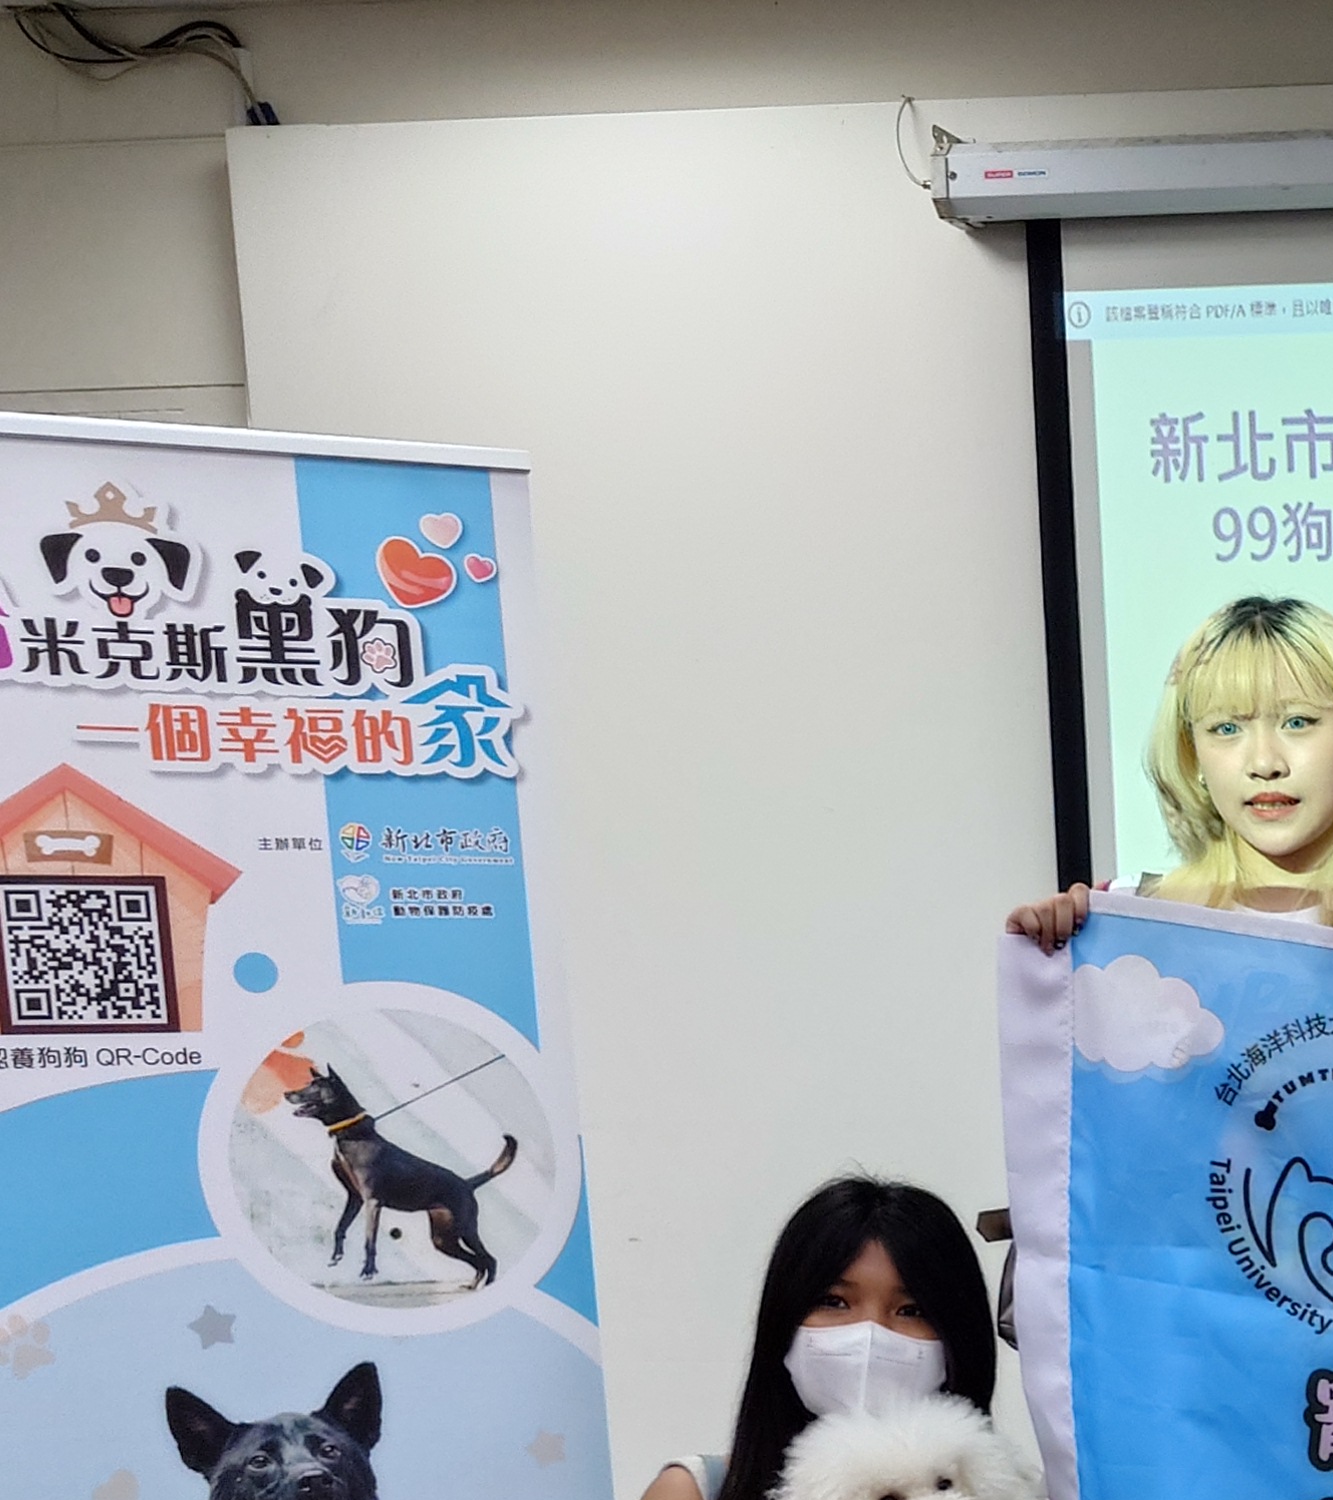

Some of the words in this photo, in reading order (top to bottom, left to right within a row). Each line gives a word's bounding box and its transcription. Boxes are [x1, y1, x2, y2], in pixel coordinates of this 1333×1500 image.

[1206, 304, 1246, 319] PDF/A
[0, 590, 414, 687] 米克斯黑狗
[76, 675, 512, 767] 一個幸福的家
[258, 837, 323, 851] 主辦單位
[381, 827, 510, 853] 新北市政府
[392, 889, 463, 900] 新北市政府
[96, 1047, 202, 1066] QR-Code
[1272, 1068, 1329, 1103] TUMT
[1206, 1158, 1238, 1237] Taipei
[1228, 1235, 1333, 1335] University
